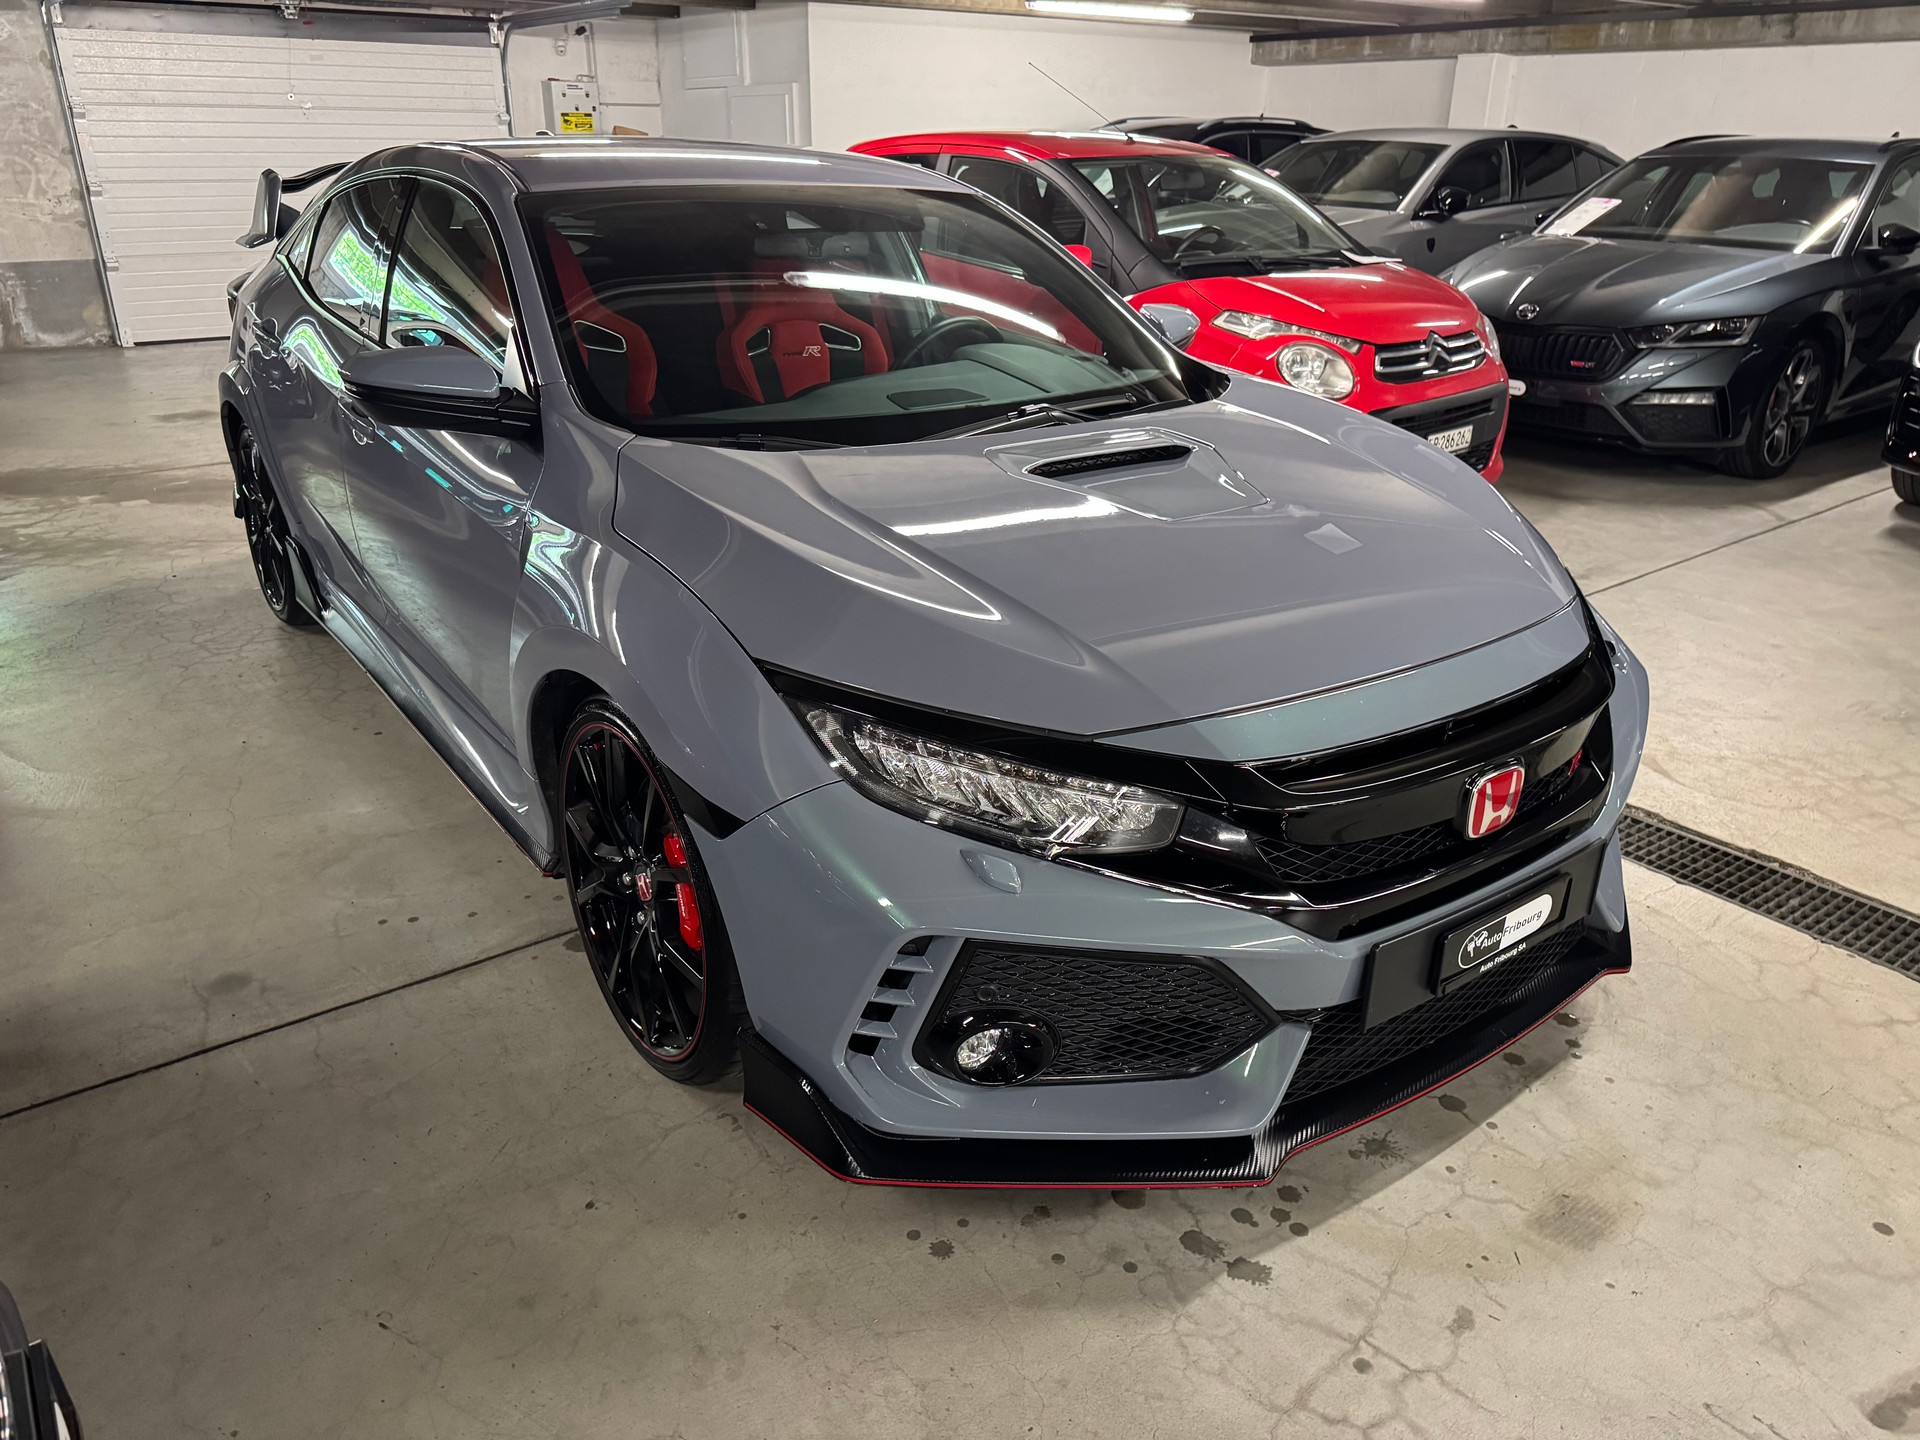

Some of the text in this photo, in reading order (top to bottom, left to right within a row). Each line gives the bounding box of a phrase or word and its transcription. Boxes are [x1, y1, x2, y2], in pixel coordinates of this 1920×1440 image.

[1481, 910, 1542, 950] Auto Fribourg
[1480, 941, 1527, 973] Auto Fribourg SA
